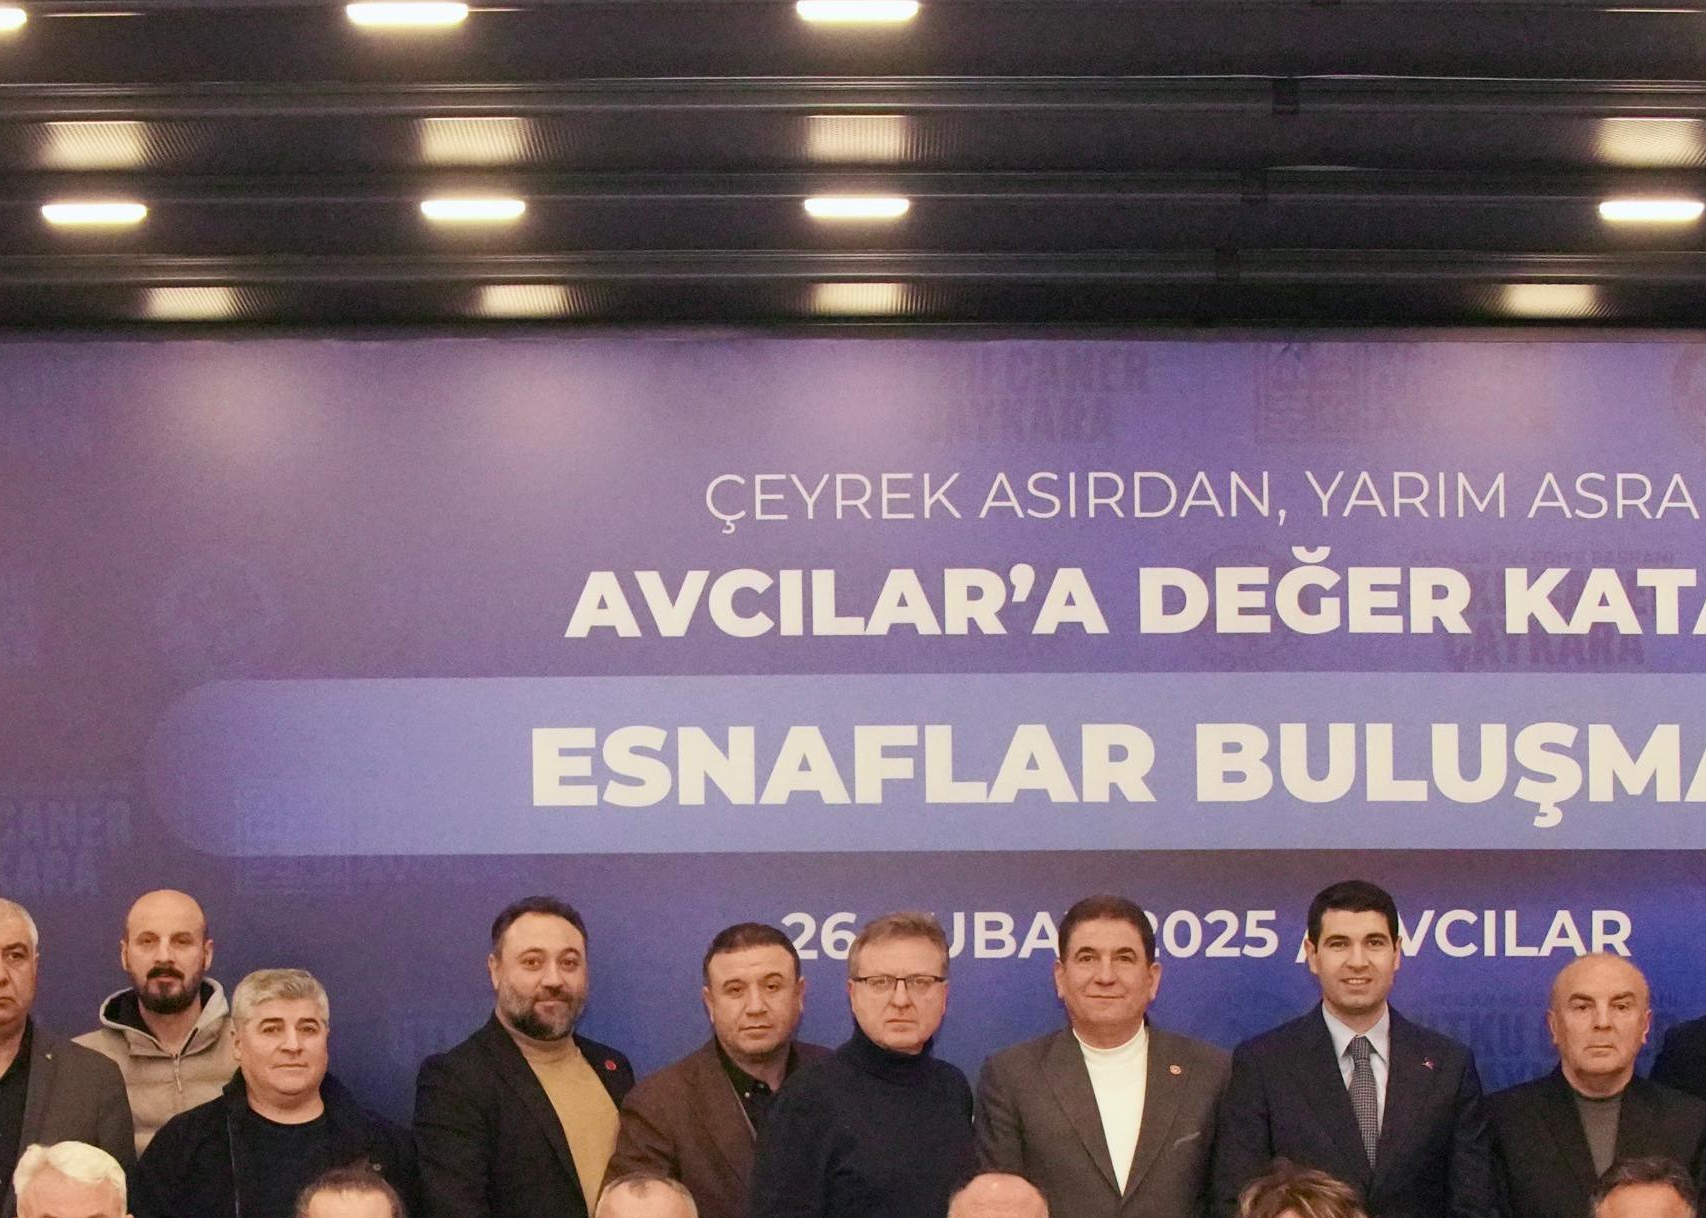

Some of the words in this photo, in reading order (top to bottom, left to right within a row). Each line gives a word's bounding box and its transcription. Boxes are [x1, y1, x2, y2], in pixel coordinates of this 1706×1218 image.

[704, 471, 962, 535] ÇEYREK
[978, 470, 1288, 526] ASIRDAN,
[1305, 470, 1506, 519] YARIM
[1526, 471, 1700, 520] ASRA
[1138, 546, 1473, 636] DEĞER
[531, 722, 1158, 809] ESNAFLAR
[780, 911, 857, 960] 26
[1396, 909, 1632, 958] VCILAR
